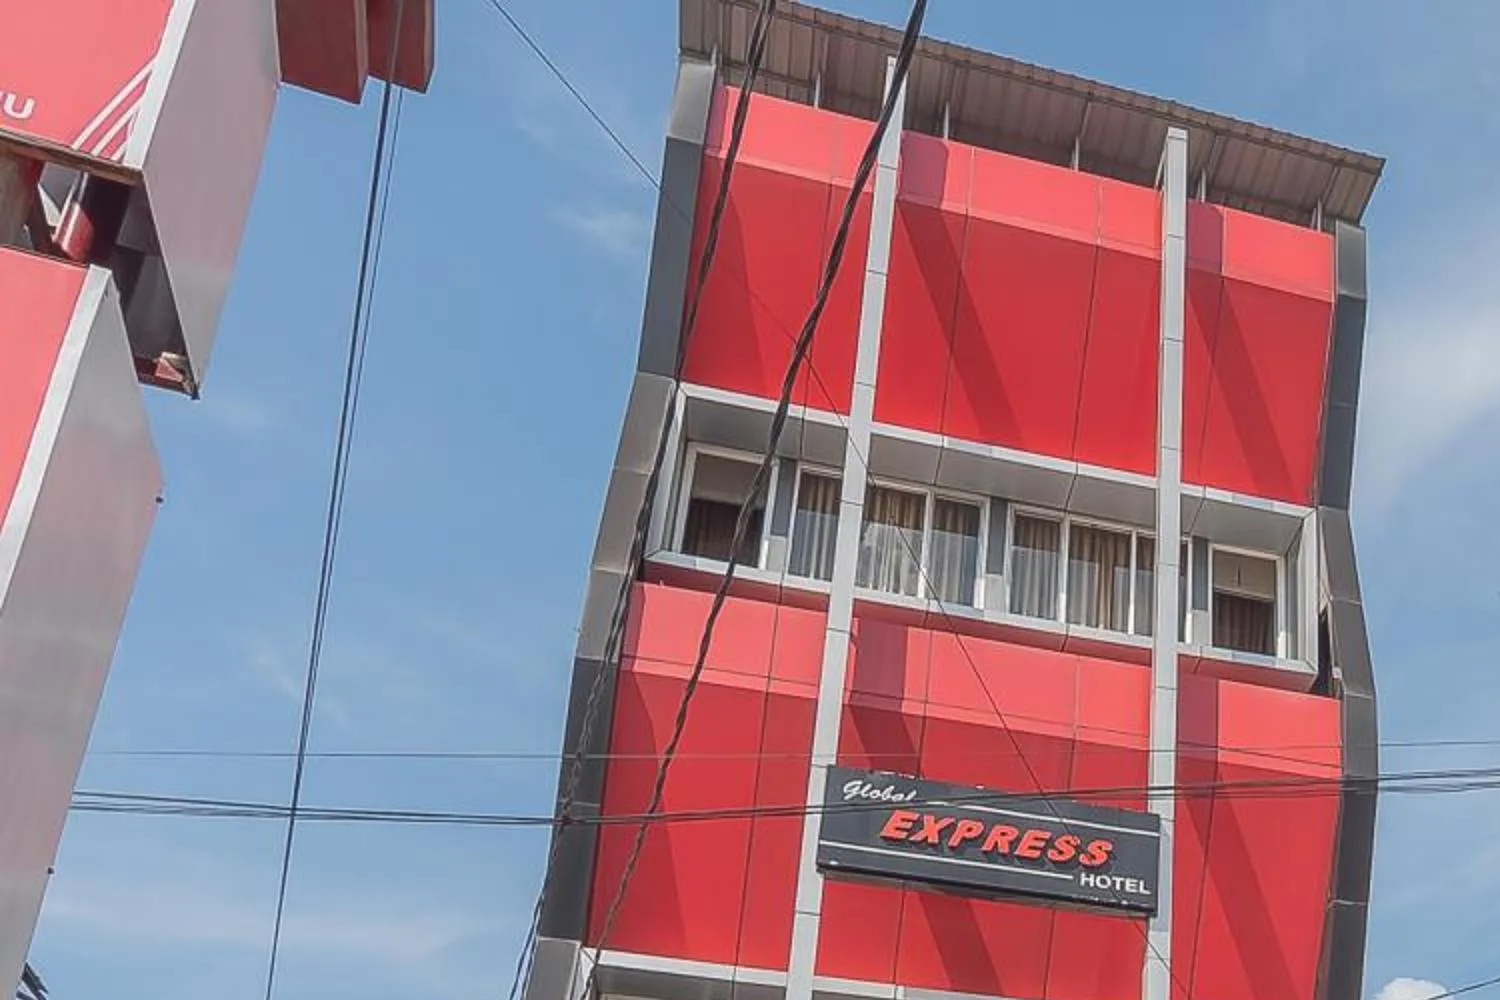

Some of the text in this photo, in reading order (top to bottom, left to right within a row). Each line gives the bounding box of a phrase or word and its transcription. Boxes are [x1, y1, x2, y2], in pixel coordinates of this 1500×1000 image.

[0, 91, 35, 119] U
[843, 780, 918, 802] Global
[879, 809, 1114, 868] EXPRESS
[1079, 872, 1152, 895] HOTEL
